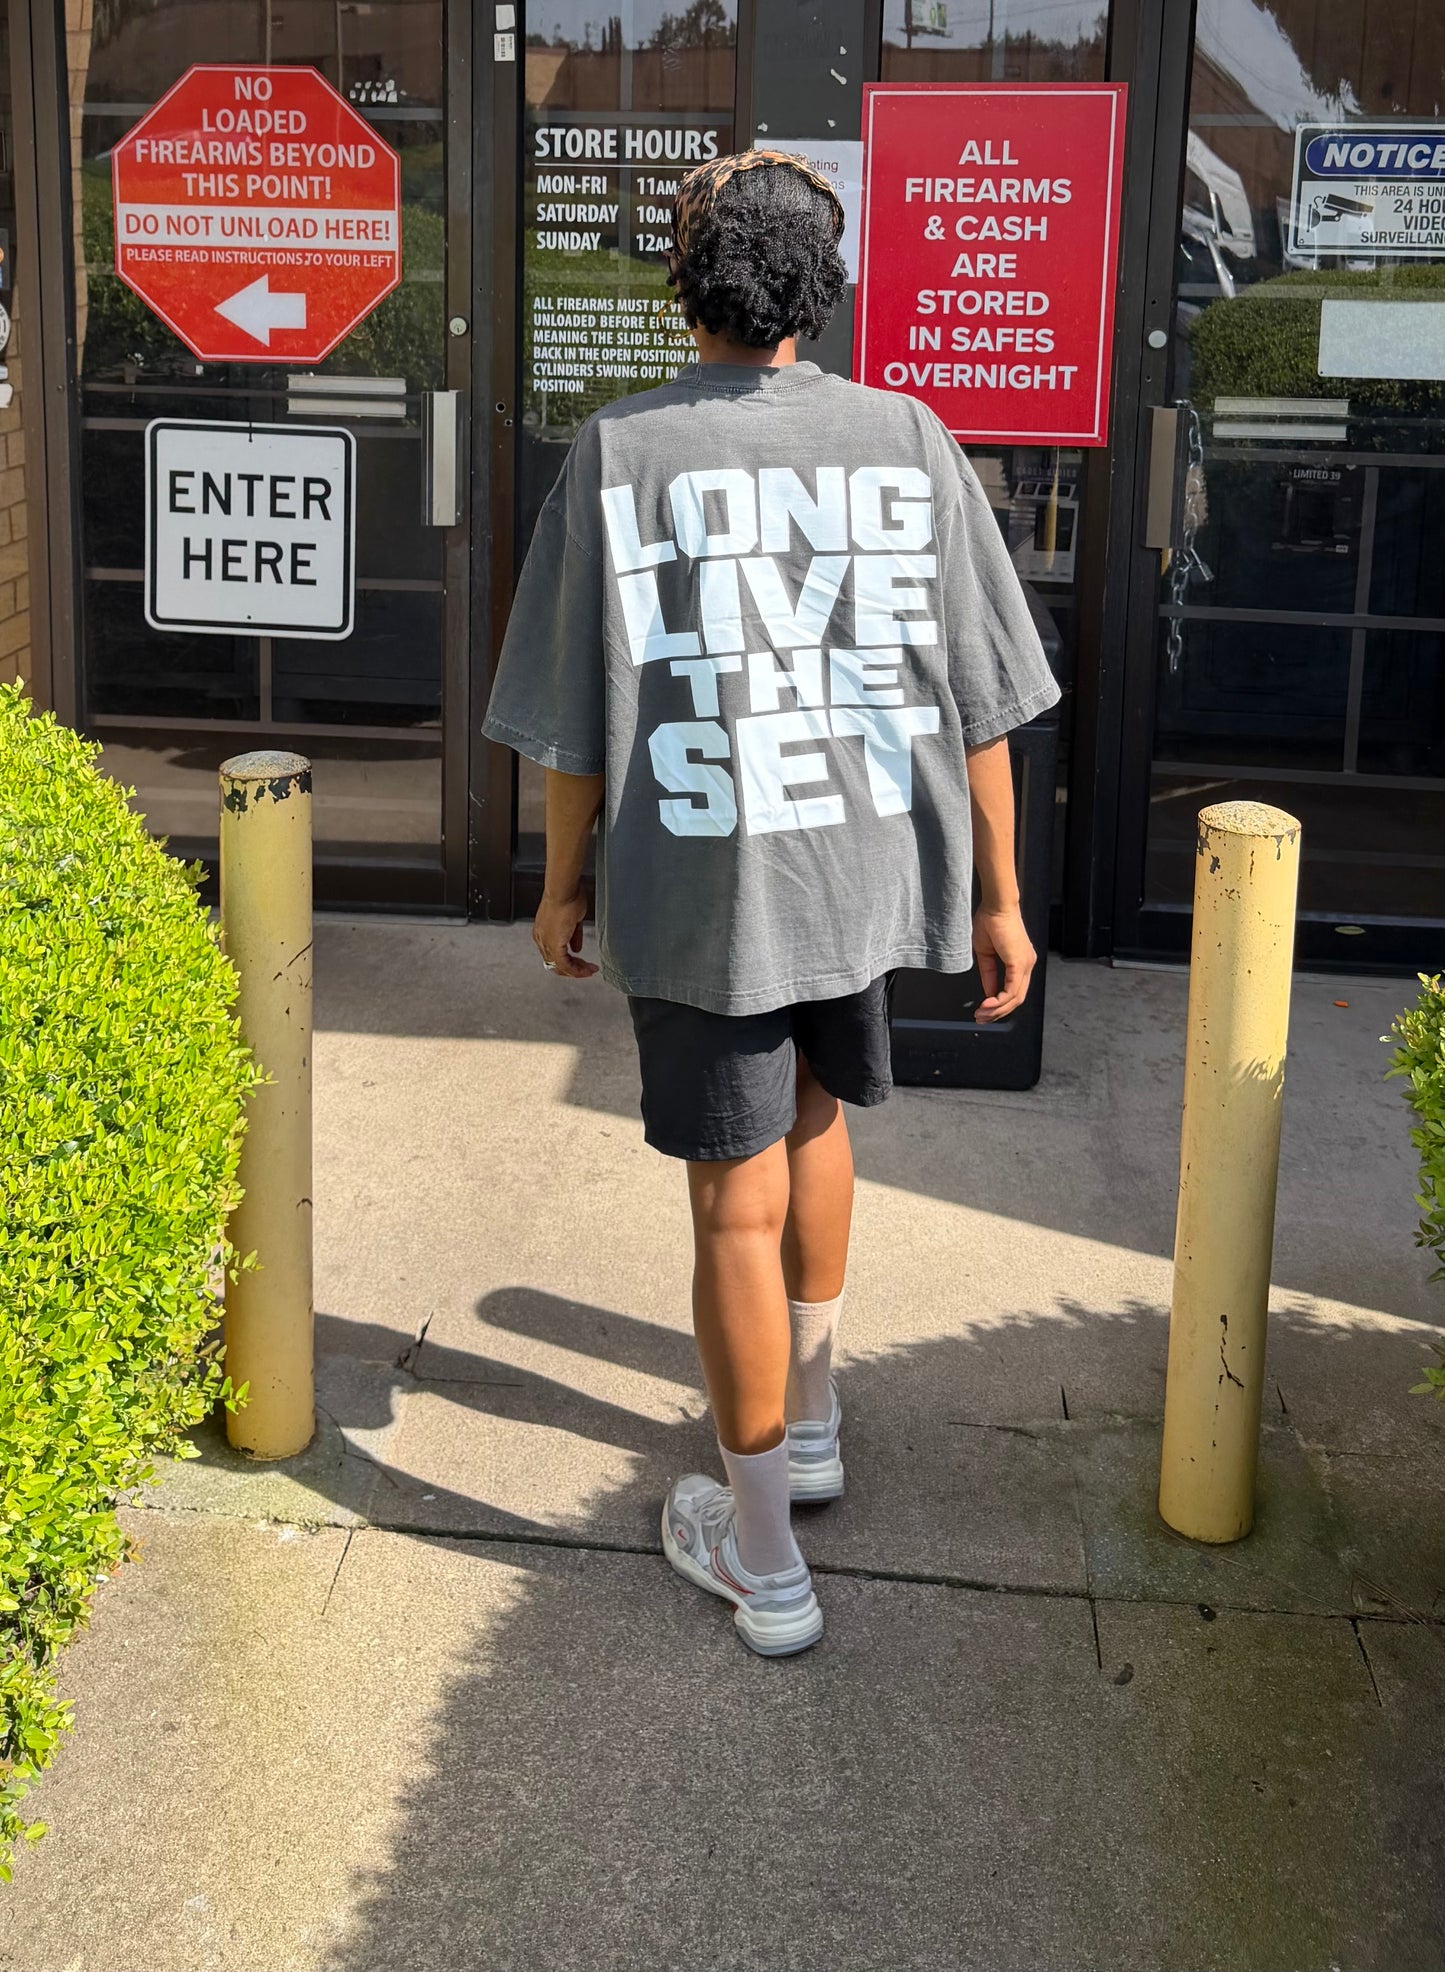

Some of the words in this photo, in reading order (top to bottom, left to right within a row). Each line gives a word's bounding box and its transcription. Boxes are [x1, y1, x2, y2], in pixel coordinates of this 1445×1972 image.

[234, 76, 273, 101] NO
[202, 108, 307, 135] LOADED
[135, 139, 262, 167] FIREARMS
[269, 142, 375, 169] BEYOND
[534, 128, 617, 159] STORE
[625, 129, 718, 160] HOURS
[958, 140, 1019, 165] ALL
[1323, 143, 1445, 169] NOTICE
[182, 173, 240, 198] THIS
[246, 174, 332, 200] POINT!
[536, 175, 607, 195] MON-FRI
[905, 178, 1072, 204] FIREARMS
[1354, 185, 1379, 196] THIS
[1381, 186, 1410, 196] AREA
[1414, 186, 1424, 197] IS
[536, 203, 619, 223] SATURDAY
[1393, 199, 1414, 214] 24
[125, 213, 159, 235] DO
[165, 215, 214, 236] NOT
[220, 216, 319, 239] UNLOAD
[325, 218, 390, 241] HERE!
[924, 215, 946, 240] &
[955, 215, 1048, 241] CASH
[1361, 232, 1445, 244] SURVEILLAN
[536, 231, 601, 251] SUNDAY
[126, 248, 173, 262] PLEASE
[175, 250, 209, 263] READ
[211, 251, 303, 265] INSTRUCTIONS
[304, 252, 323, 266] TO
[325, 253, 361, 267] YOUR
[363, 255, 393, 268] LEFT
[950, 253, 1017, 278] ARE
[533, 297, 554, 311] ALL
[556, 297, 615, 312] FIREARMS
[617, 299, 650, 313] MUST
[916, 290, 1050, 316] STORED
[533, 313, 596, 328] UNLOADED
[600, 315, 645, 330] BEFORE
[533, 330, 588, 345] MEANING
[591, 332, 613, 345] THE
[616, 332, 650, 346] SLIDE
[653, 333, 665, 347] IS
[668, 334, 699, 347] LOCK
[909, 327, 941, 351] IN
[951, 327, 1055, 353] SAFES
[533, 347, 562, 360] BACK
[564, 347, 577, 361] IN
[578, 348, 600, 361] THE
[601, 348, 632, 363] OPEN
[633, 350, 685, 363] POSITION
[533, 363, 594, 377] CYLINDERS
[595, 365, 638, 379] SWUNG
[640, 366, 663, 380] OUT
[665, 367, 678, 380] IN
[883, 362, 1078, 391] OVERNIGHT
[533, 380, 584, 394] POSITION
[1293, 469, 1328, 480] LIMITED
[169, 470, 332, 520] ENTER
[600, 466, 933, 574] LONG
[182, 537, 317, 586] HERE
[617, 554, 937, 667] LIVE
[669, 646, 905, 718] THE
[647, 706, 940, 837] SET
